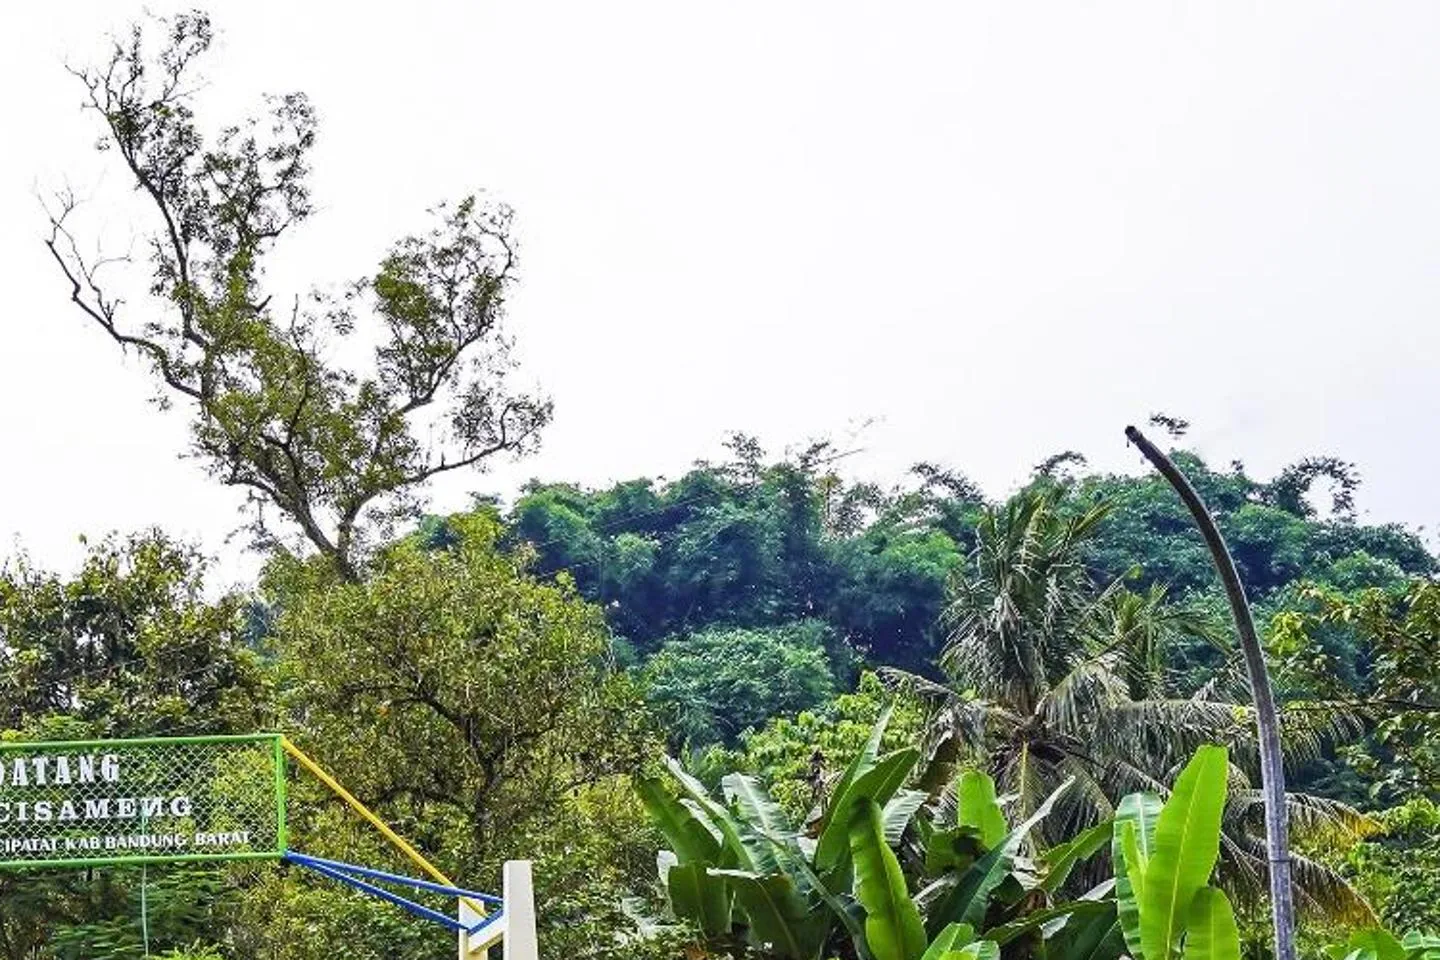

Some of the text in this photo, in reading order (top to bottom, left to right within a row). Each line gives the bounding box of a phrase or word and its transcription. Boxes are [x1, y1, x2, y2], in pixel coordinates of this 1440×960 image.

[65, 836, 101, 850] KAB
[105, 833, 187, 849] BANDUNG
[194, 831, 251, 846] BARAT
